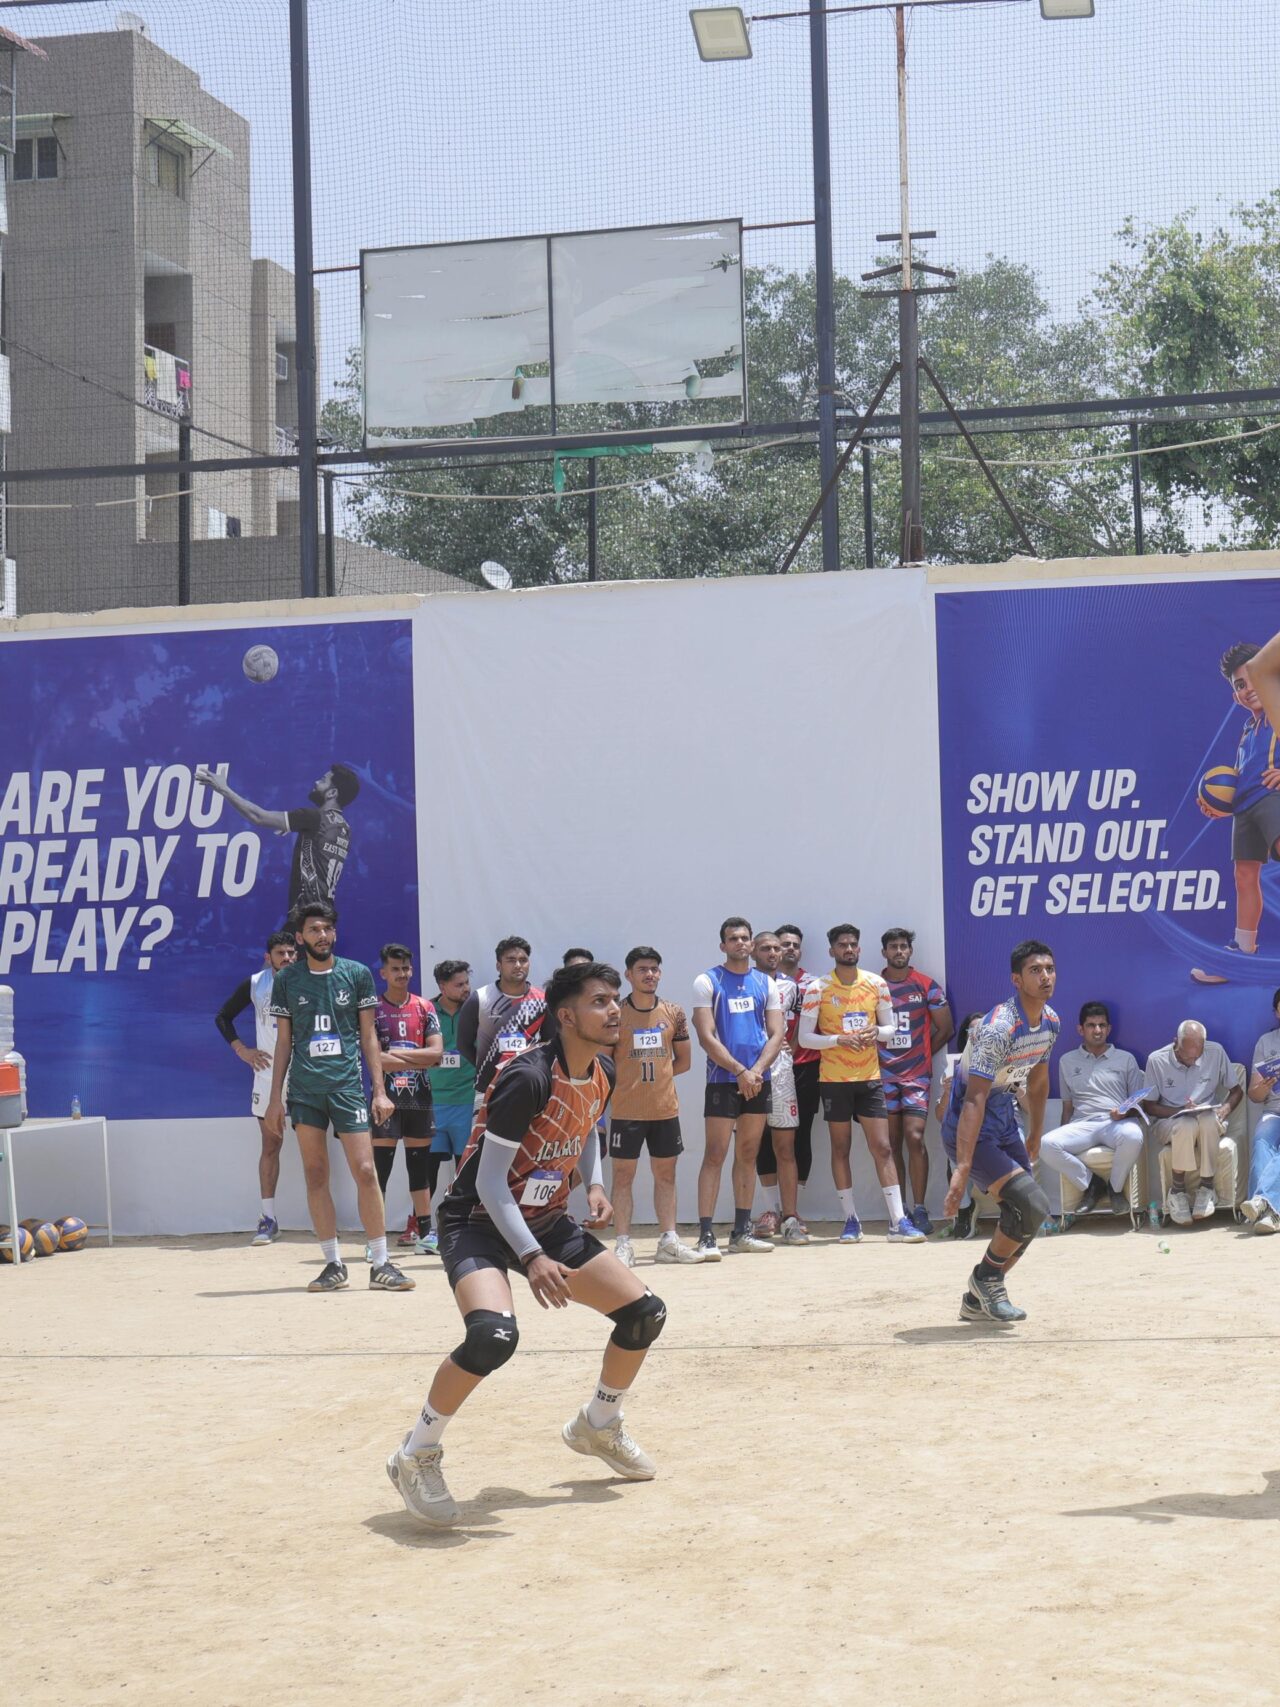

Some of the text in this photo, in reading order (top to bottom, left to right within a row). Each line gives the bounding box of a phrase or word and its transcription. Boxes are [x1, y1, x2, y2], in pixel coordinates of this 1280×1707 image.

[0, 762, 230, 837] ARE YOU
[966, 768, 1140, 816] SHOW UP.
[967, 818, 1169, 866] STAND OUT.
[0, 830, 262, 905] READY TO
[970, 869, 1227, 917] GET SELECTED.
[0, 904, 175, 975] PLAY?
[734, 1000, 750, 1010] 119
[314, 1014, 331, 1032] 10
[398, 1020, 407, 1038] 8
[848, 1018, 864, 1028] 132
[315, 1041, 335, 1053] 127
[505, 1039, 523, 1049] 142
[640, 1035, 658, 1046] 129
[892, 1037, 908, 1046] 130
[641, 1062, 655, 1082] 11
[355, 1108, 368, 1124] 10
[790, 1104, 798, 1117] 8
[611, 1132, 622, 1148] 11
[533, 1183, 557, 1201] 106
